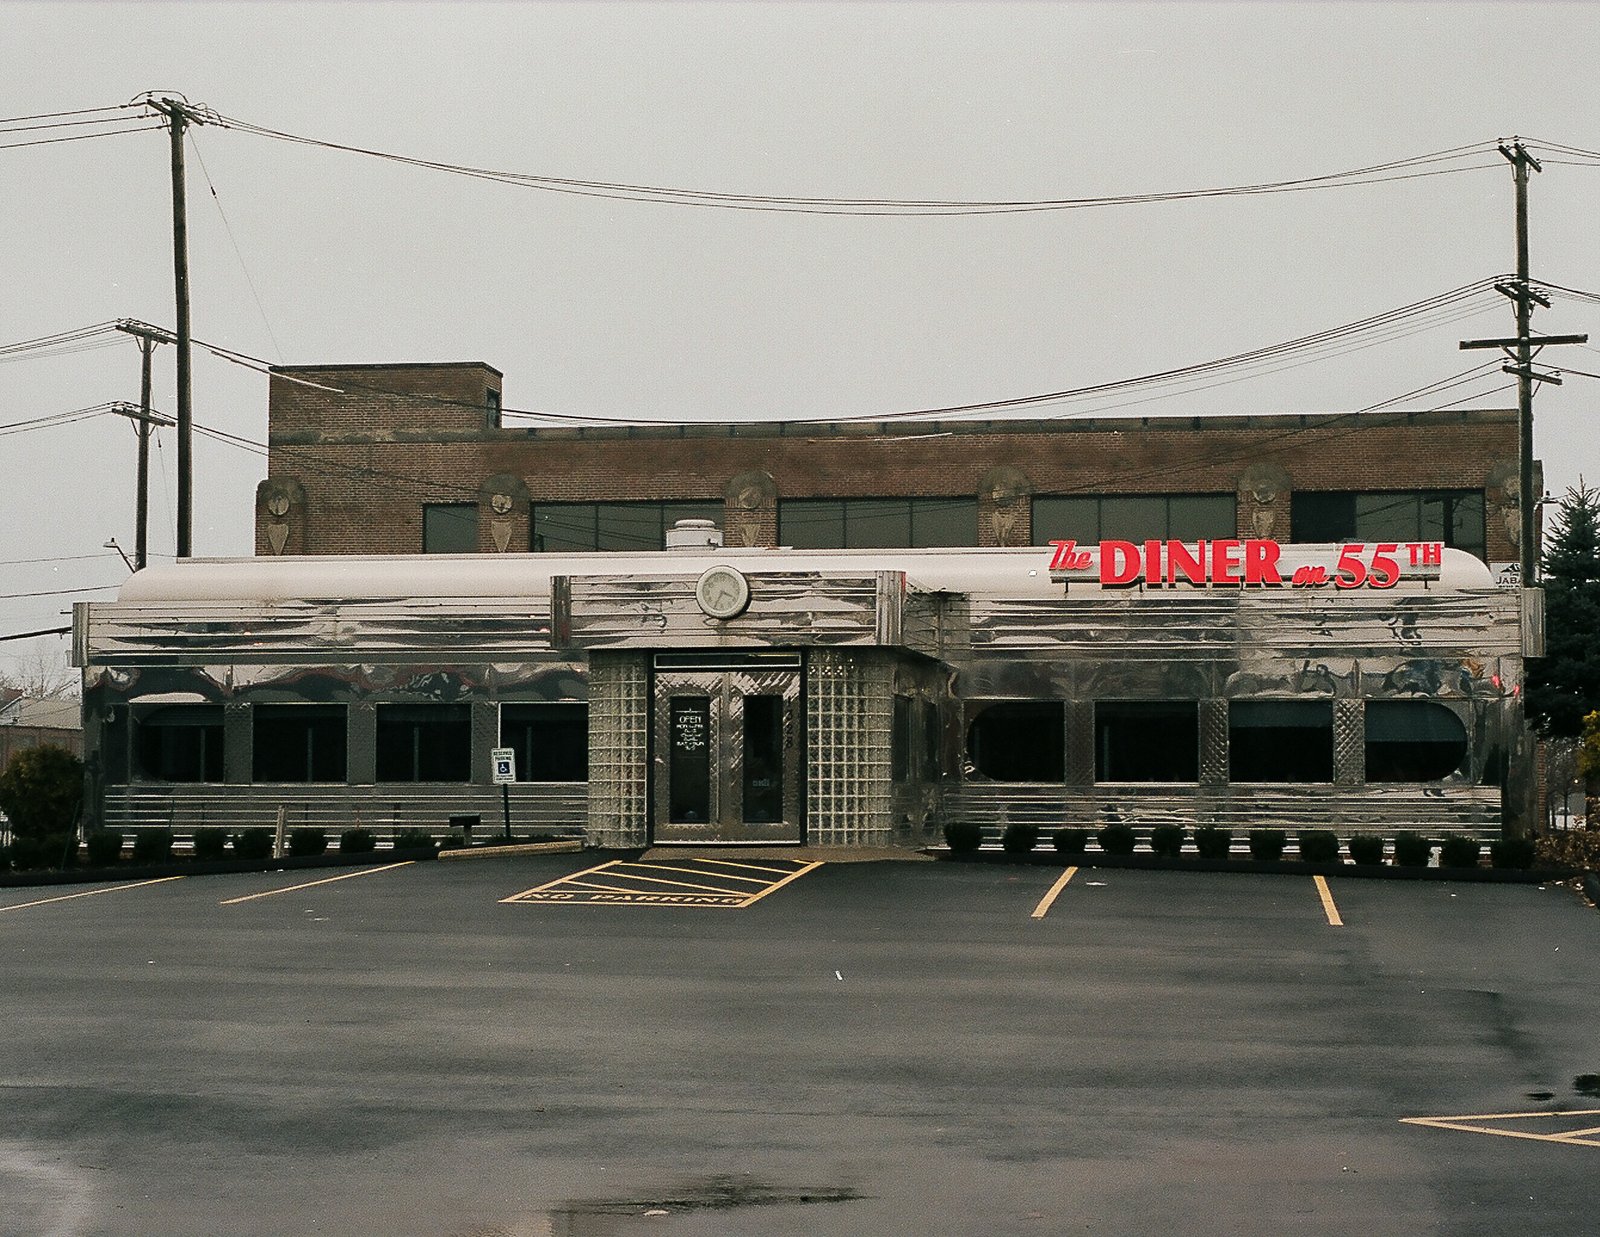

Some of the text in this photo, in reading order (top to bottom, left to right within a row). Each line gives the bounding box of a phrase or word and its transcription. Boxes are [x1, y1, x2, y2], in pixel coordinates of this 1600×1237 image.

[1049, 539, 1093, 570] The
[1099, 539, 1283, 585] DINER
[1292, 566, 1330, 585] on
[679, 715, 702, 724] OPEN
[590, 895, 744, 903] PARKING
